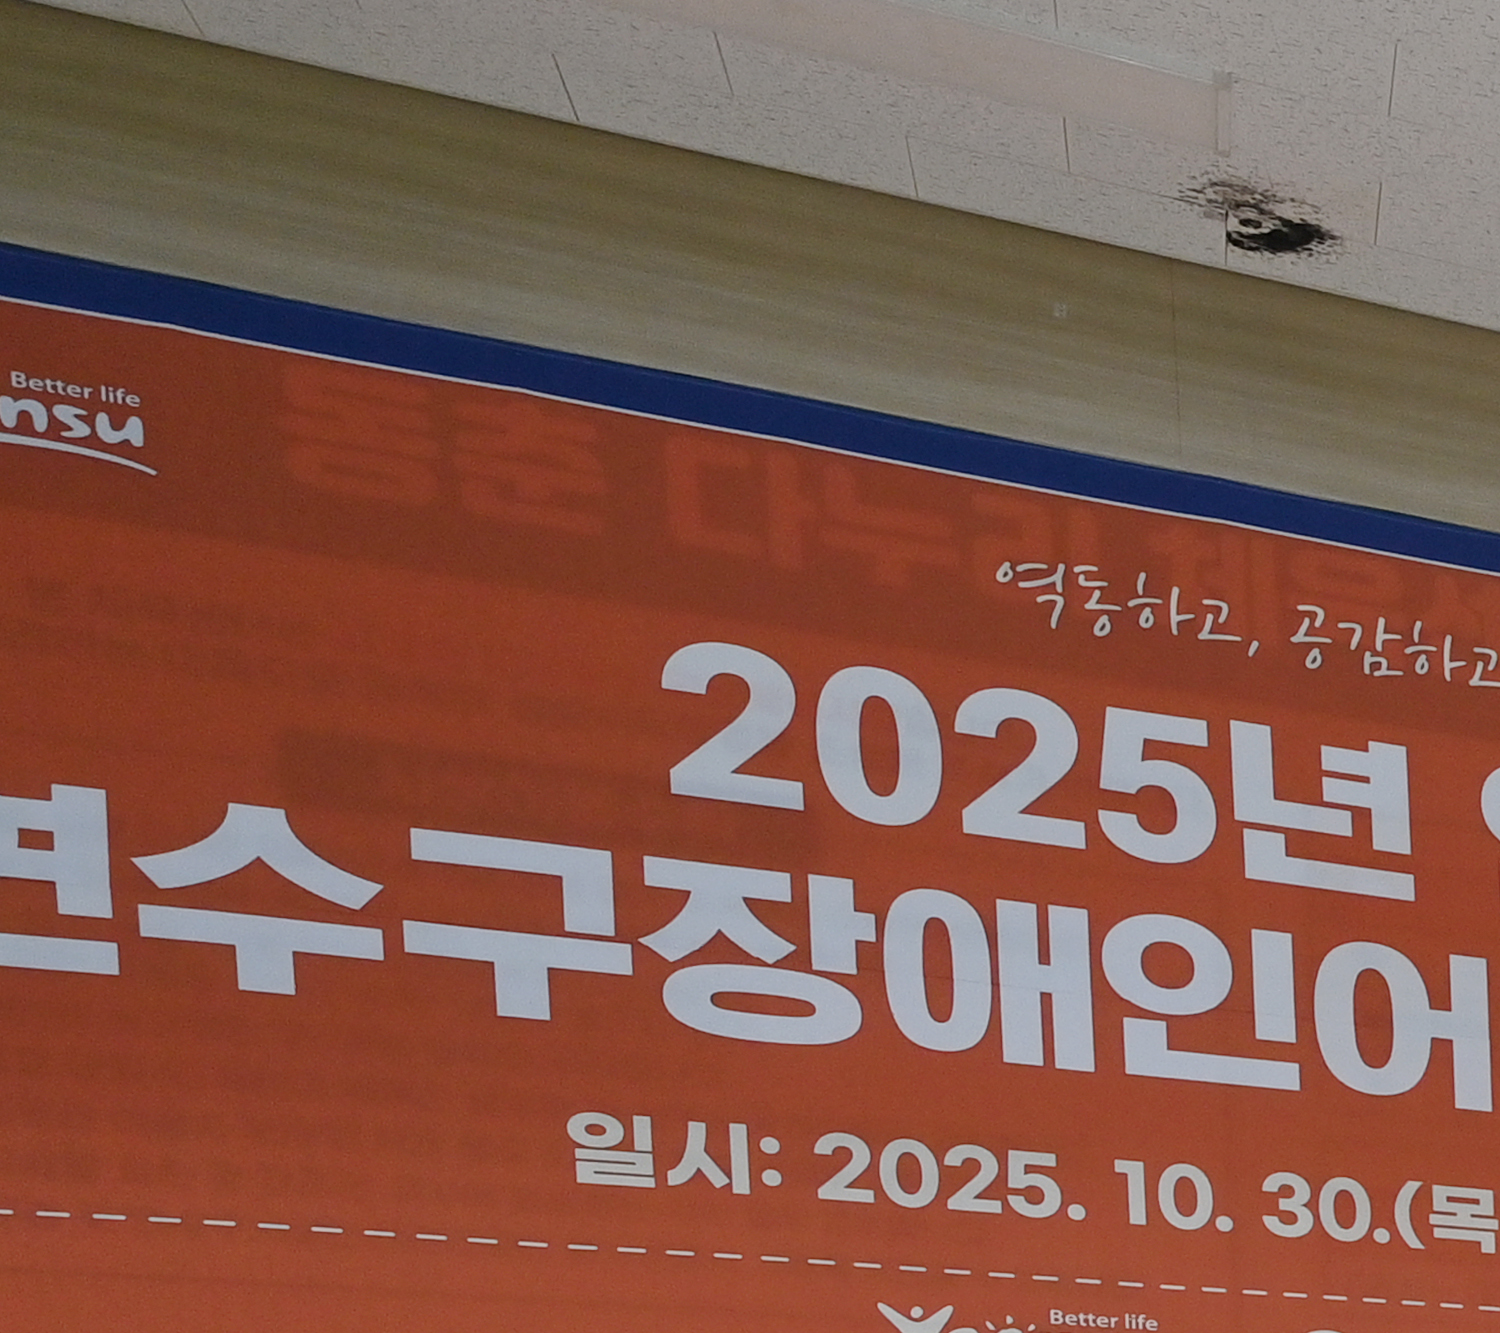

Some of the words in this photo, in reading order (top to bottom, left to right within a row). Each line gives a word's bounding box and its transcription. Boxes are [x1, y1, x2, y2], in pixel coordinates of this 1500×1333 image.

[11, 371, 93, 399] Better
[100, 385, 140, 407] life
[996, 562, 1259, 657] 역동하고,
[661, 642, 1416, 901] 2025년
[567, 1112, 783, 1195] 일시:
[814, 1132, 1087, 1220] 2025.
[1114, 1159, 1234, 1232] 10.
[1050, 1309, 1119, 1328] Better
[1125, 1313, 1158, 1331] life
